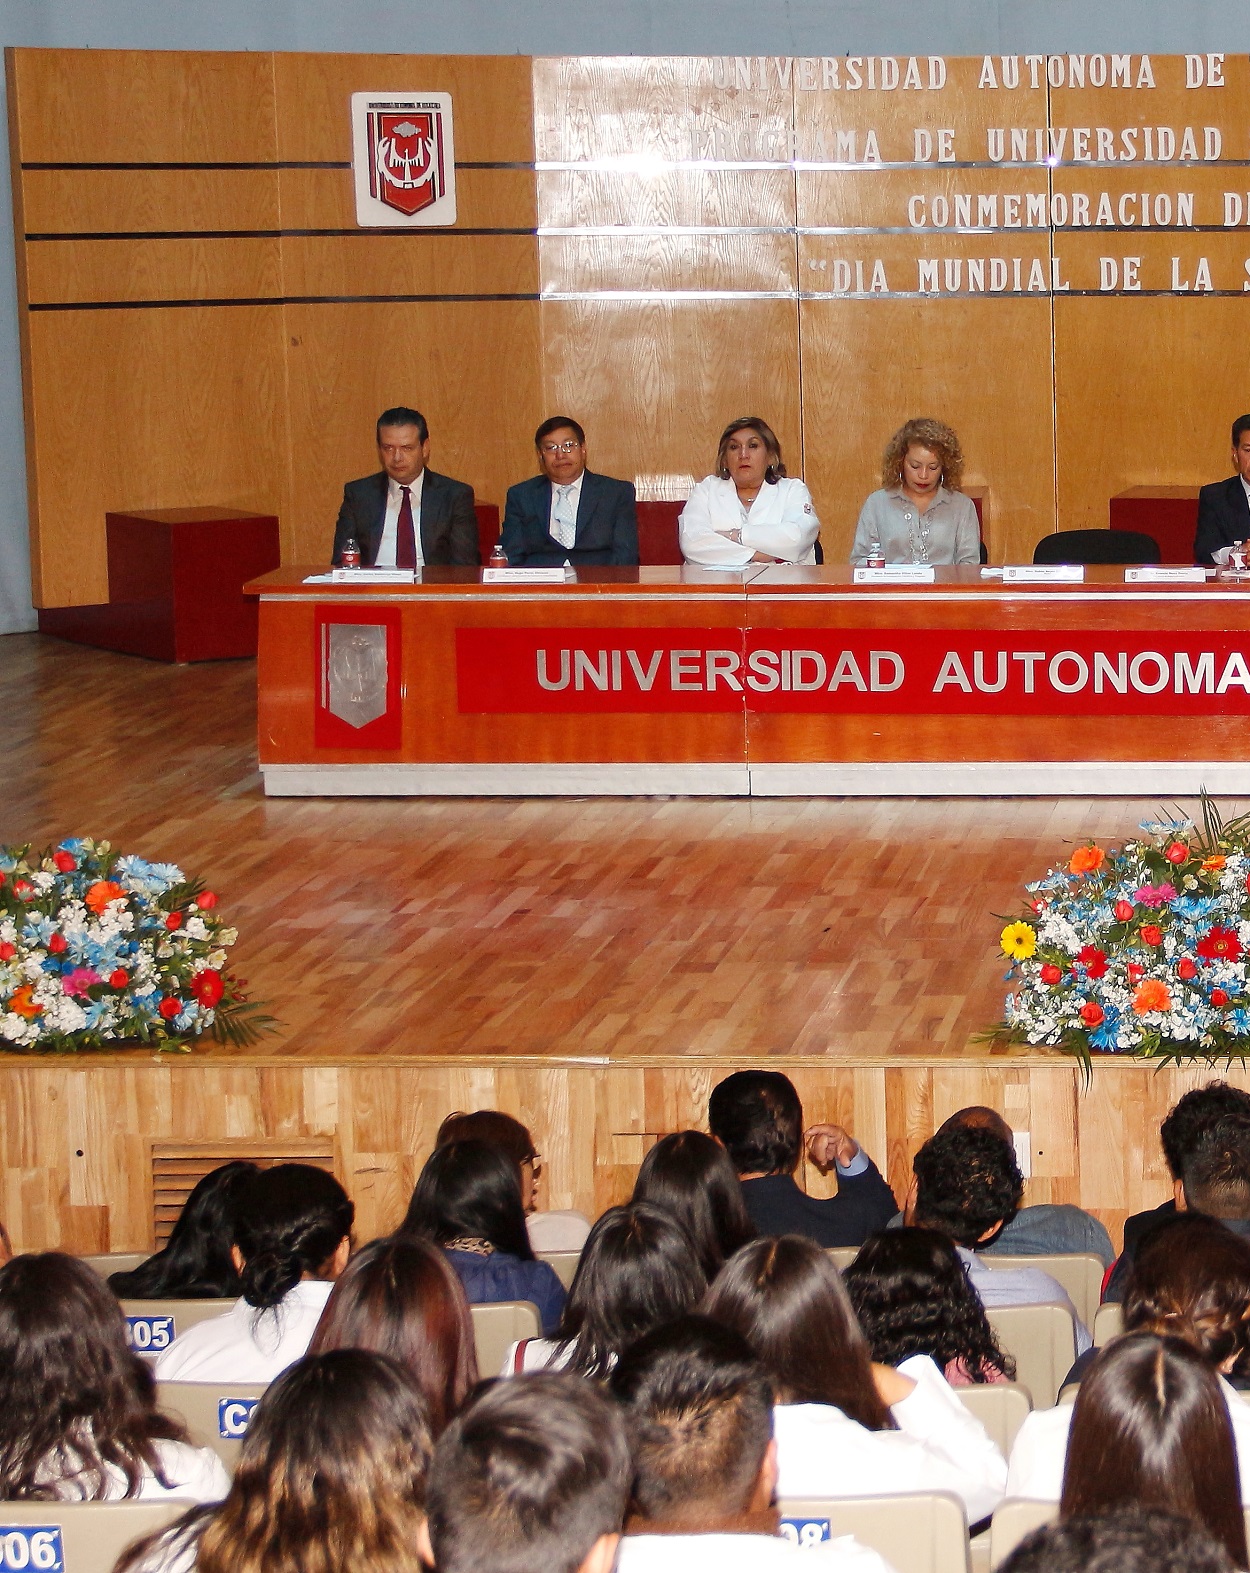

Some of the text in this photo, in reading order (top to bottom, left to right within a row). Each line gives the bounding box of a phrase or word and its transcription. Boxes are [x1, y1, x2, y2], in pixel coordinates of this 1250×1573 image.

[712, 56, 947, 91] UNIVERSIDAD
[978, 55, 1156, 90] AUTONOMA
[1186, 54, 1226, 89] DE
[690, 129, 882, 163] PROGRAMA
[913, 128, 956, 163] DE
[987, 127, 1223, 162] UNIVERSIDAD
[908, 192, 1195, 227] CONMEMORACION
[918, 257, 1071, 293] MUNDIAL
[1100, 257, 1143, 292] DE
[1172, 257, 1214, 292] LA
[536, 649, 905, 694] UNIVERSIDAD
[0, 1531, 56, 1569] 06
